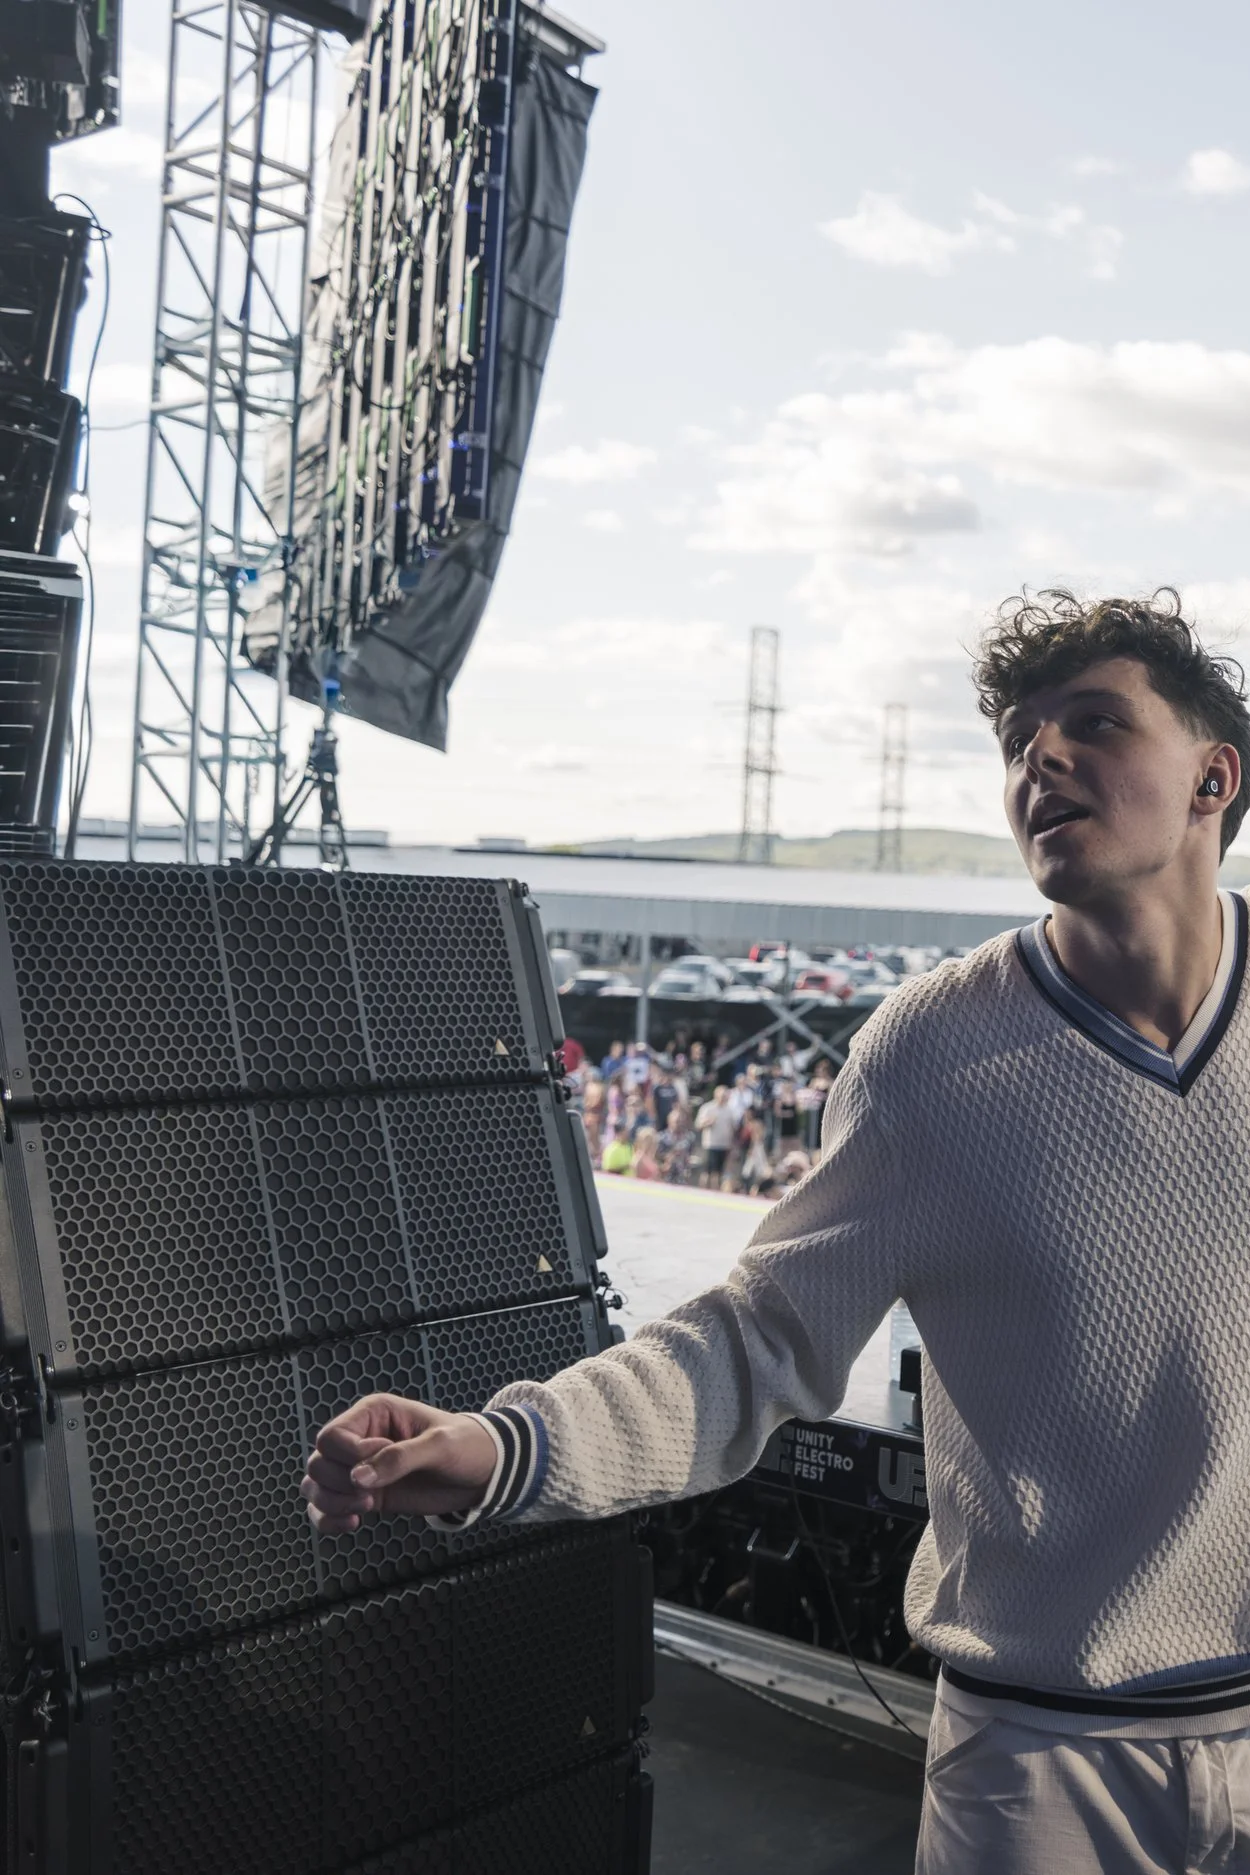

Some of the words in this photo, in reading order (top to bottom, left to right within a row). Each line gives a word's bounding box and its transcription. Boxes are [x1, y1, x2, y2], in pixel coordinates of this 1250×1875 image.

[796, 1428, 835, 1449] UNITY
[795, 1444, 854, 1471] ELECTRO
[794, 1461, 826, 1482] FEST
